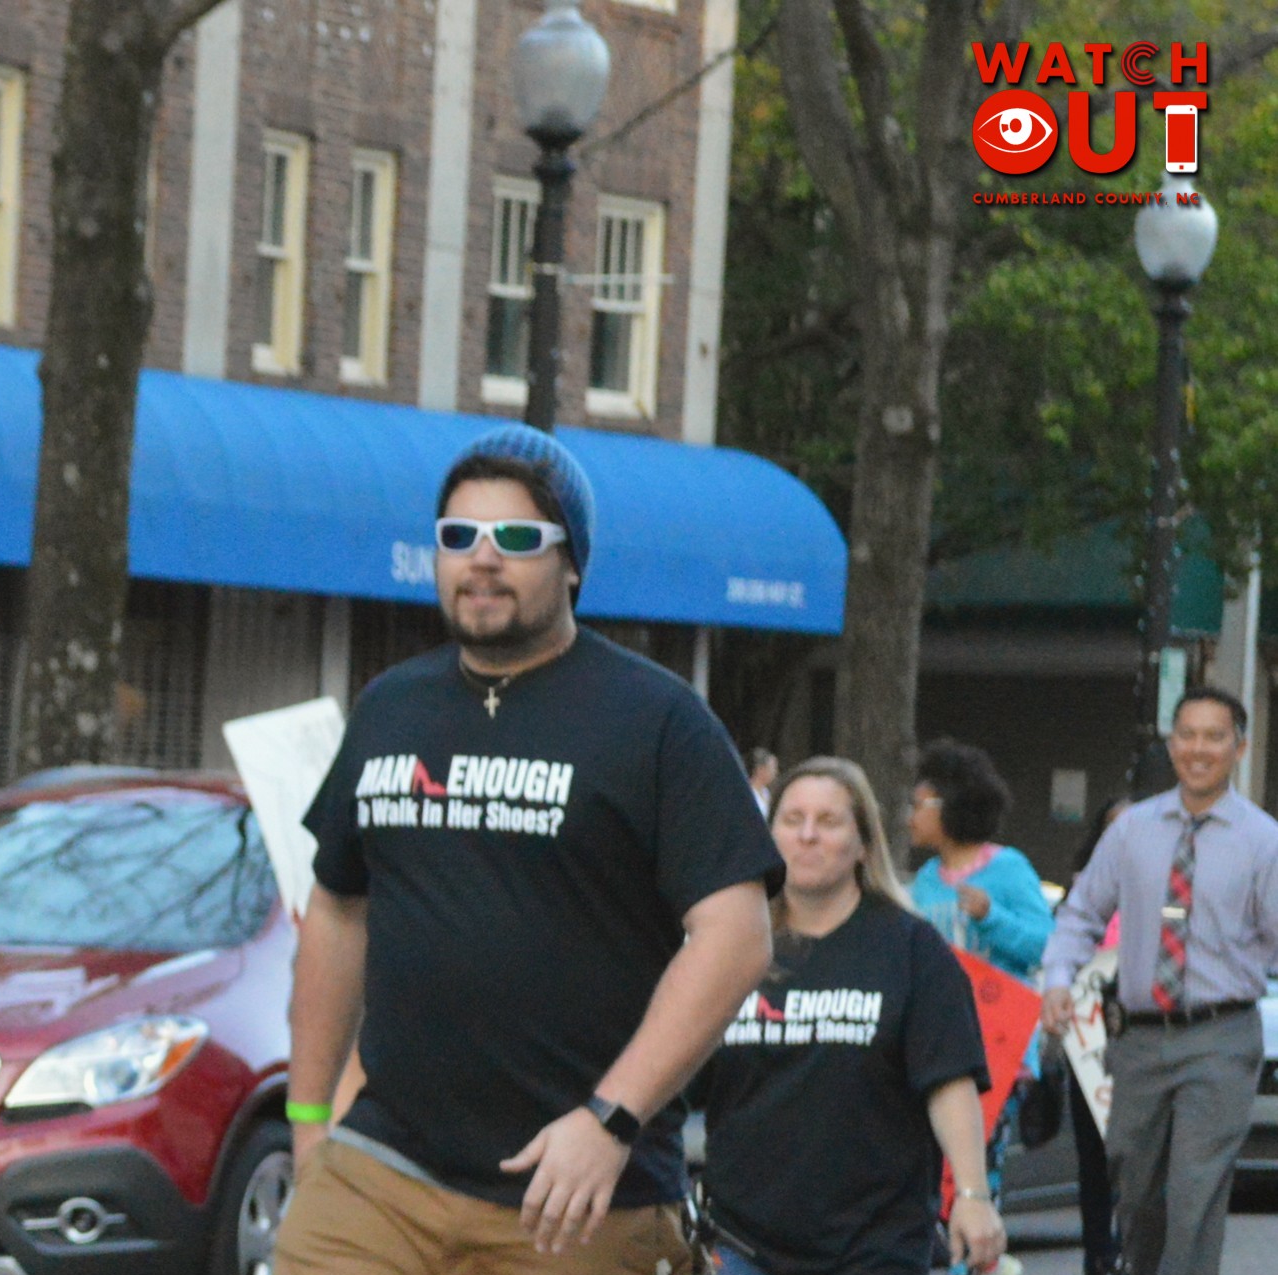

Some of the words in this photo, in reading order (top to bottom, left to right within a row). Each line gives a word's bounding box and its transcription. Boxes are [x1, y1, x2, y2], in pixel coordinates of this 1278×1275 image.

[446, 754, 574, 806] ENOUGH
[371, 797, 420, 828] Walk
[446, 799, 483, 830] Her
[485, 801, 565, 838] Shoes?
[784, 988, 883, 1023] ENOUGH
[784, 1020, 814, 1045] Her
[815, 1020, 878, 1046] Shoes?
